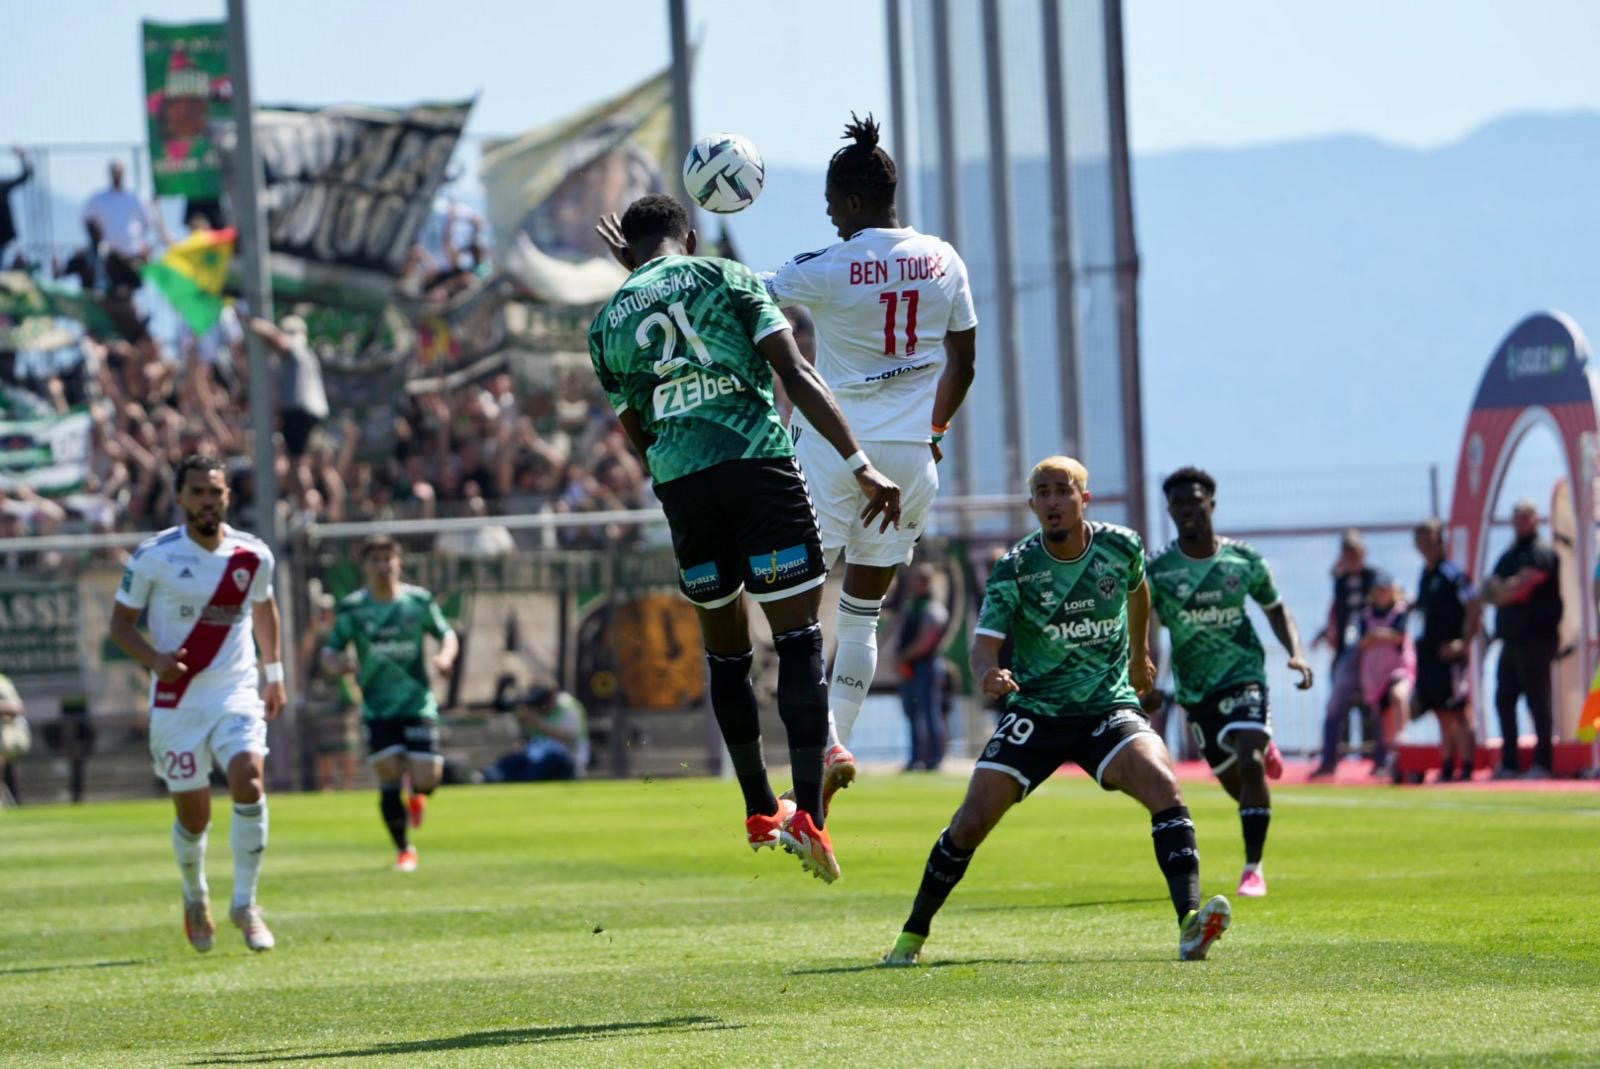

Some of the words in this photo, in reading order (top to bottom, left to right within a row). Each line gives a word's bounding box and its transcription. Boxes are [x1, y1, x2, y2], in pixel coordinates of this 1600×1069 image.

[850, 261, 889, 285] BEN
[608, 270, 697, 329] BATUBINSIKA
[879, 290, 920, 357] 11
[635, 301, 713, 378] 21
[1064, 598, 1096, 612] Loire
[836, 674, 864, 690] ACA
[994, 712, 1035, 745] 29
[165, 750, 197, 780] 29
